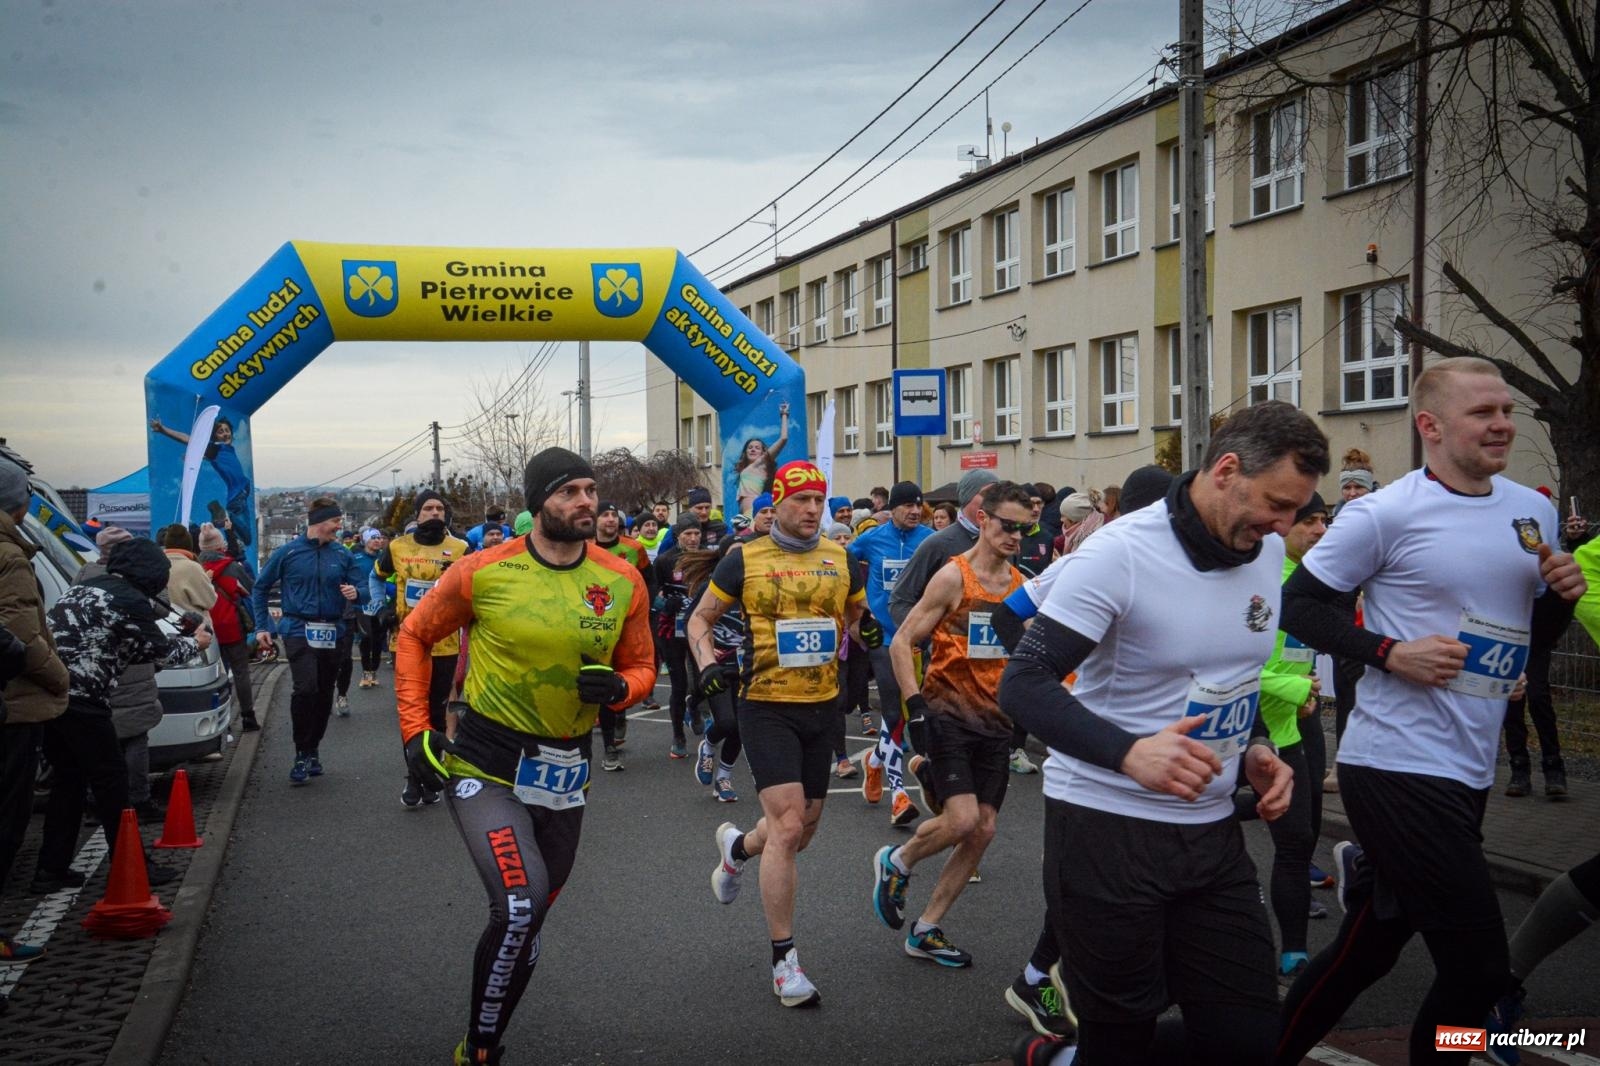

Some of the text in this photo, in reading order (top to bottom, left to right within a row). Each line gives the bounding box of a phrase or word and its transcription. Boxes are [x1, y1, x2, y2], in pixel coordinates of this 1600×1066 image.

[446, 261, 546, 277] Gmina
[421, 281, 574, 300] Pietrowice
[190, 277, 302, 380] Gmina ludzi
[440, 304, 553, 322] Wielkie
[680, 283, 779, 378] Gmina ludzi
[217, 304, 320, 399] aktywnych
[664, 306, 759, 395] aktywnych
[311, 630, 332, 641] 150
[580, 621, 617, 632] DZIKI
[795, 631, 822, 652] 38
[1479, 643, 1518, 677] 46
[1200, 698, 1250, 737] 140
[533, 763, 582, 793] 117
[478, 826, 532, 1034] 100 PROCENT DZIKI
